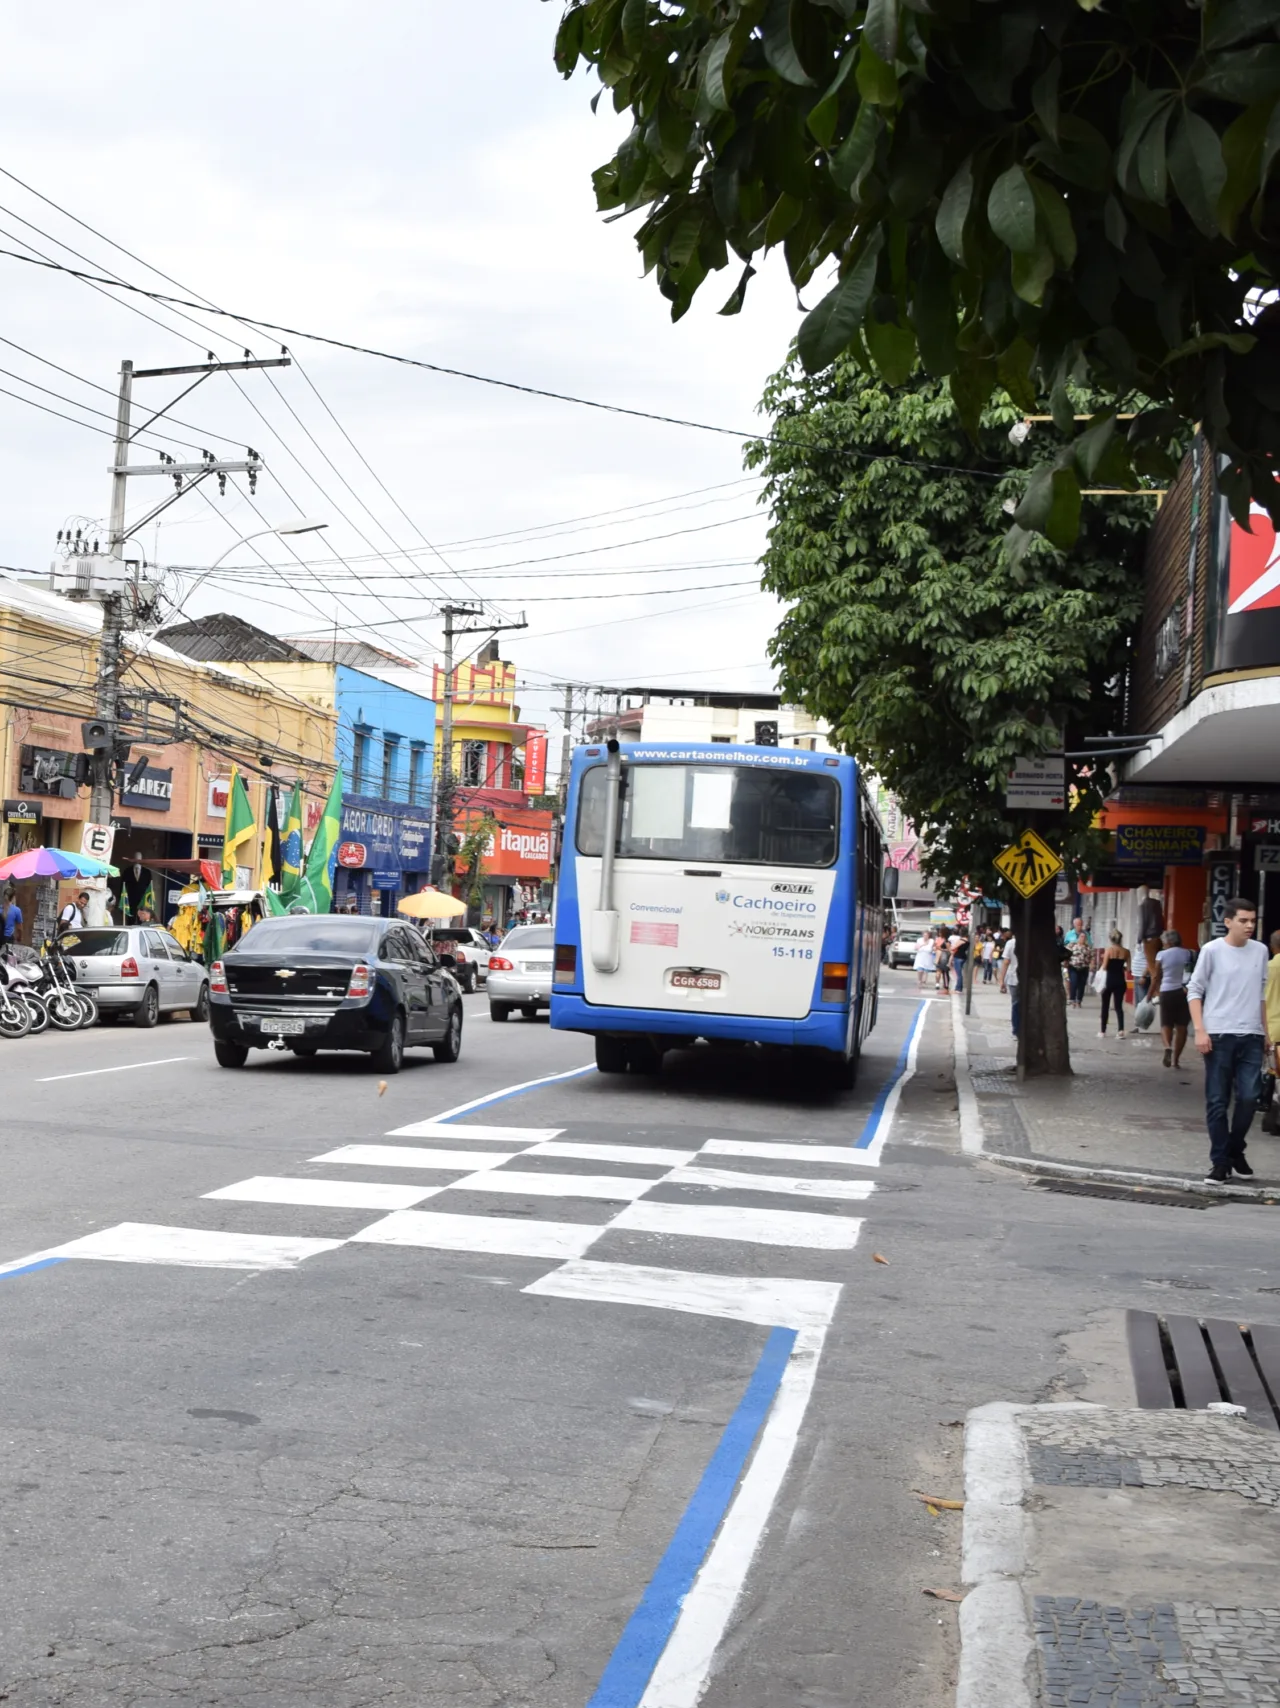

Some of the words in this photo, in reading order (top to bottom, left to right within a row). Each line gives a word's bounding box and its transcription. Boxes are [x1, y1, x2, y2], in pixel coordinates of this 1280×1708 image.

[633, 749, 809, 766] www.cartaomelhor.com.br
[1124, 827, 1198, 839] CHAVEIRO
[91, 830, 106, 851] E
[501, 828, 548, 858] itapuã
[1126, 839, 1190, 850] JOSIMAR
[524, 851, 548, 860] CALÇADOS
[771, 883, 814, 894] COMIL
[630, 902, 683, 914] Convencional
[733, 895, 816, 912] Cachoeiro
[746, 926, 815, 938] NOVOTRANS
[772, 947, 813, 960] 15-118
